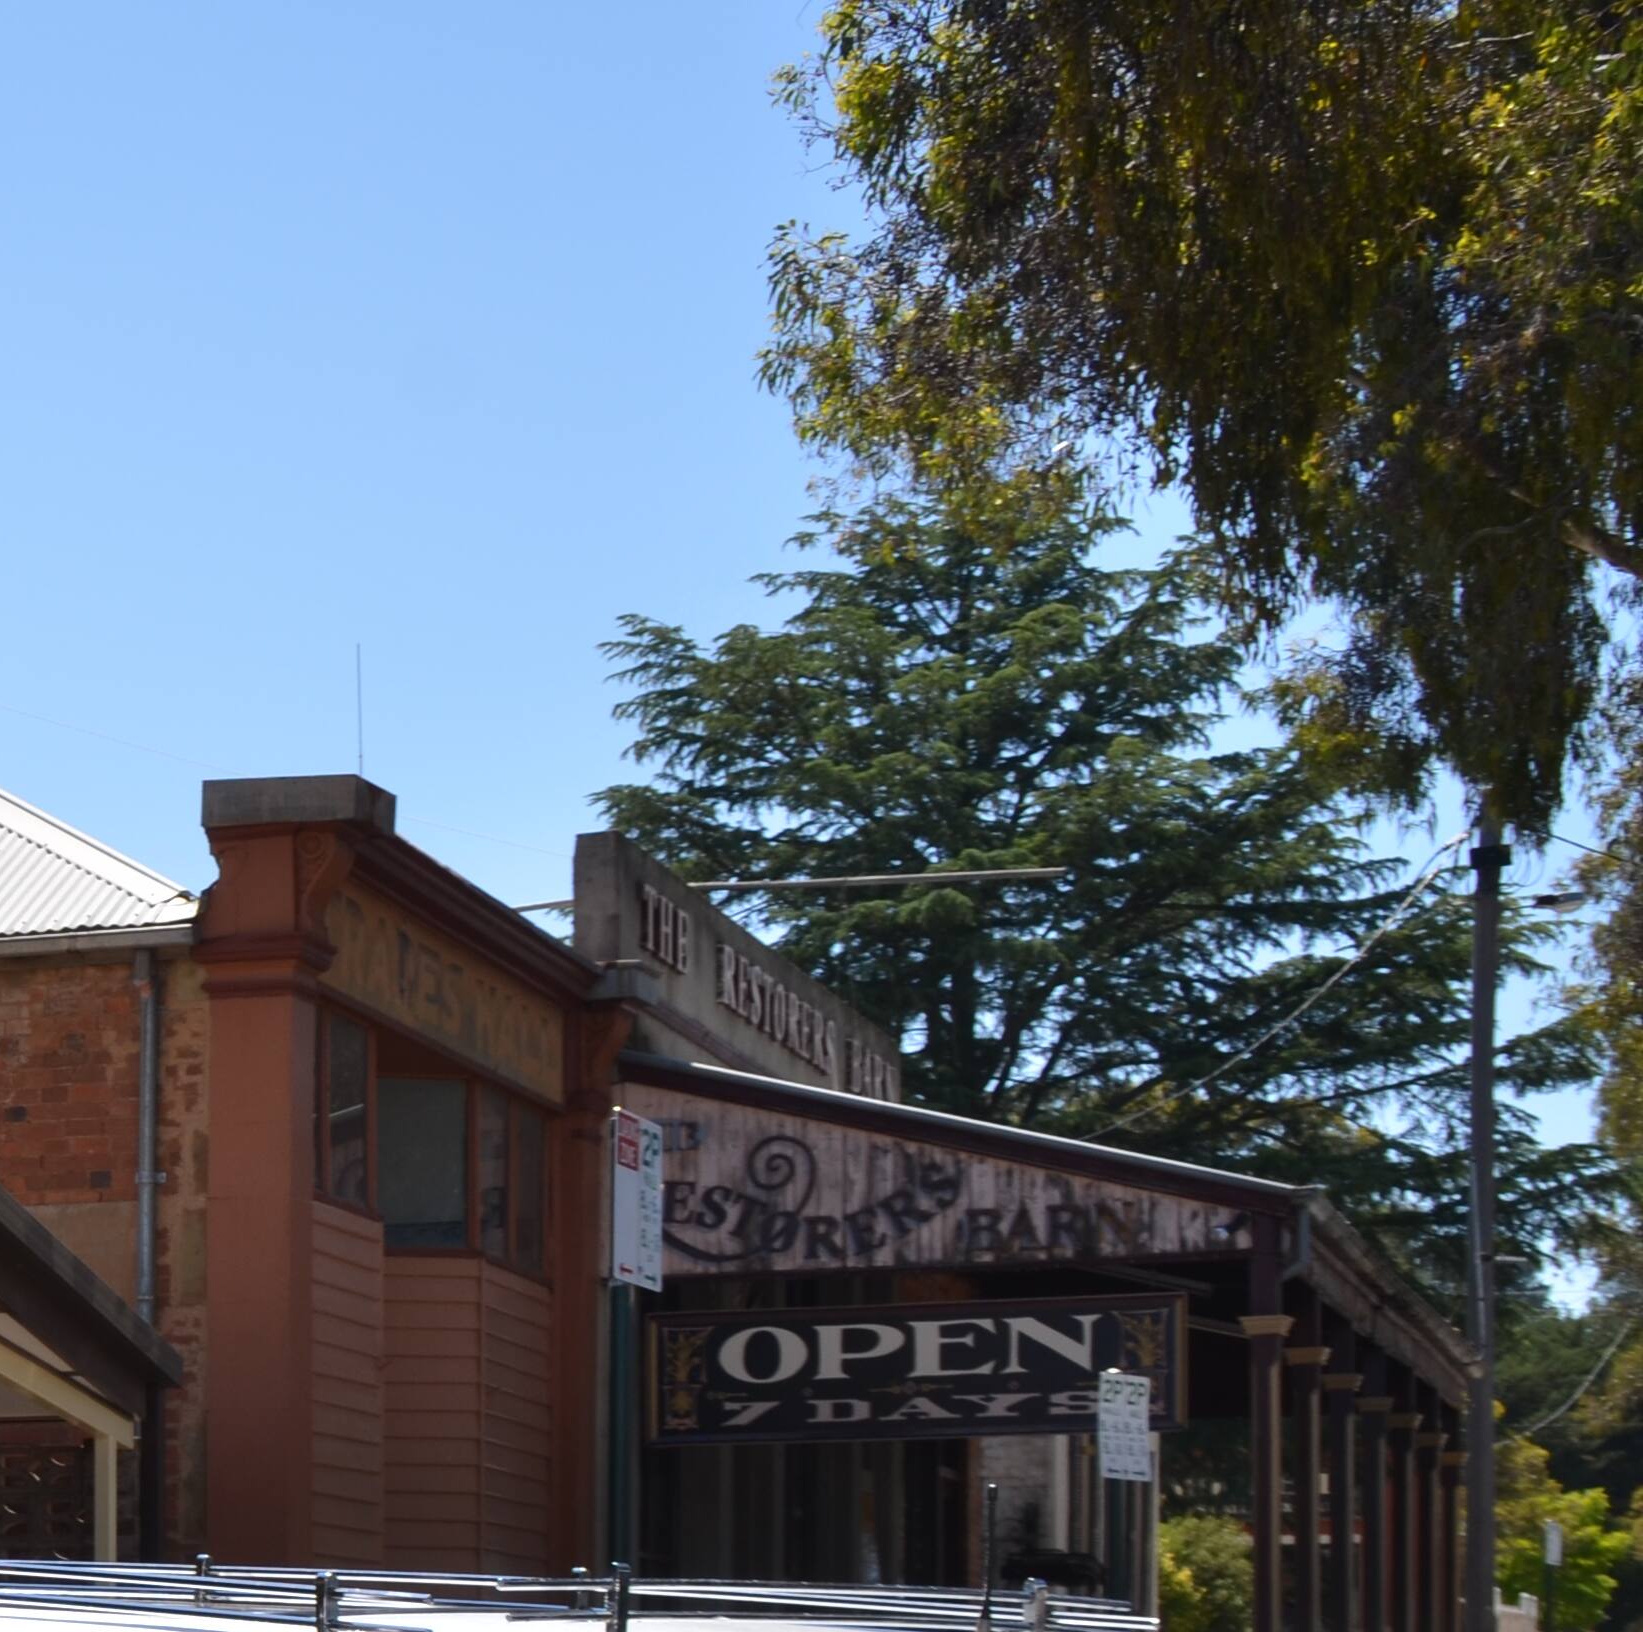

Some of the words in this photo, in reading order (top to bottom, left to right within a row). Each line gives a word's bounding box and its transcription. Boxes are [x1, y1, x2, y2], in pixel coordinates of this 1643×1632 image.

[643, 882, 691, 976] THE
[717, 943, 841, 1092] RESTORERS
[663, 1158, 961, 1259] ESTORERS
[718, 1314, 1105, 1384] OPEN
[721, 1401, 780, 1427] 7
[807, 1390, 1100, 1423] DAYS
